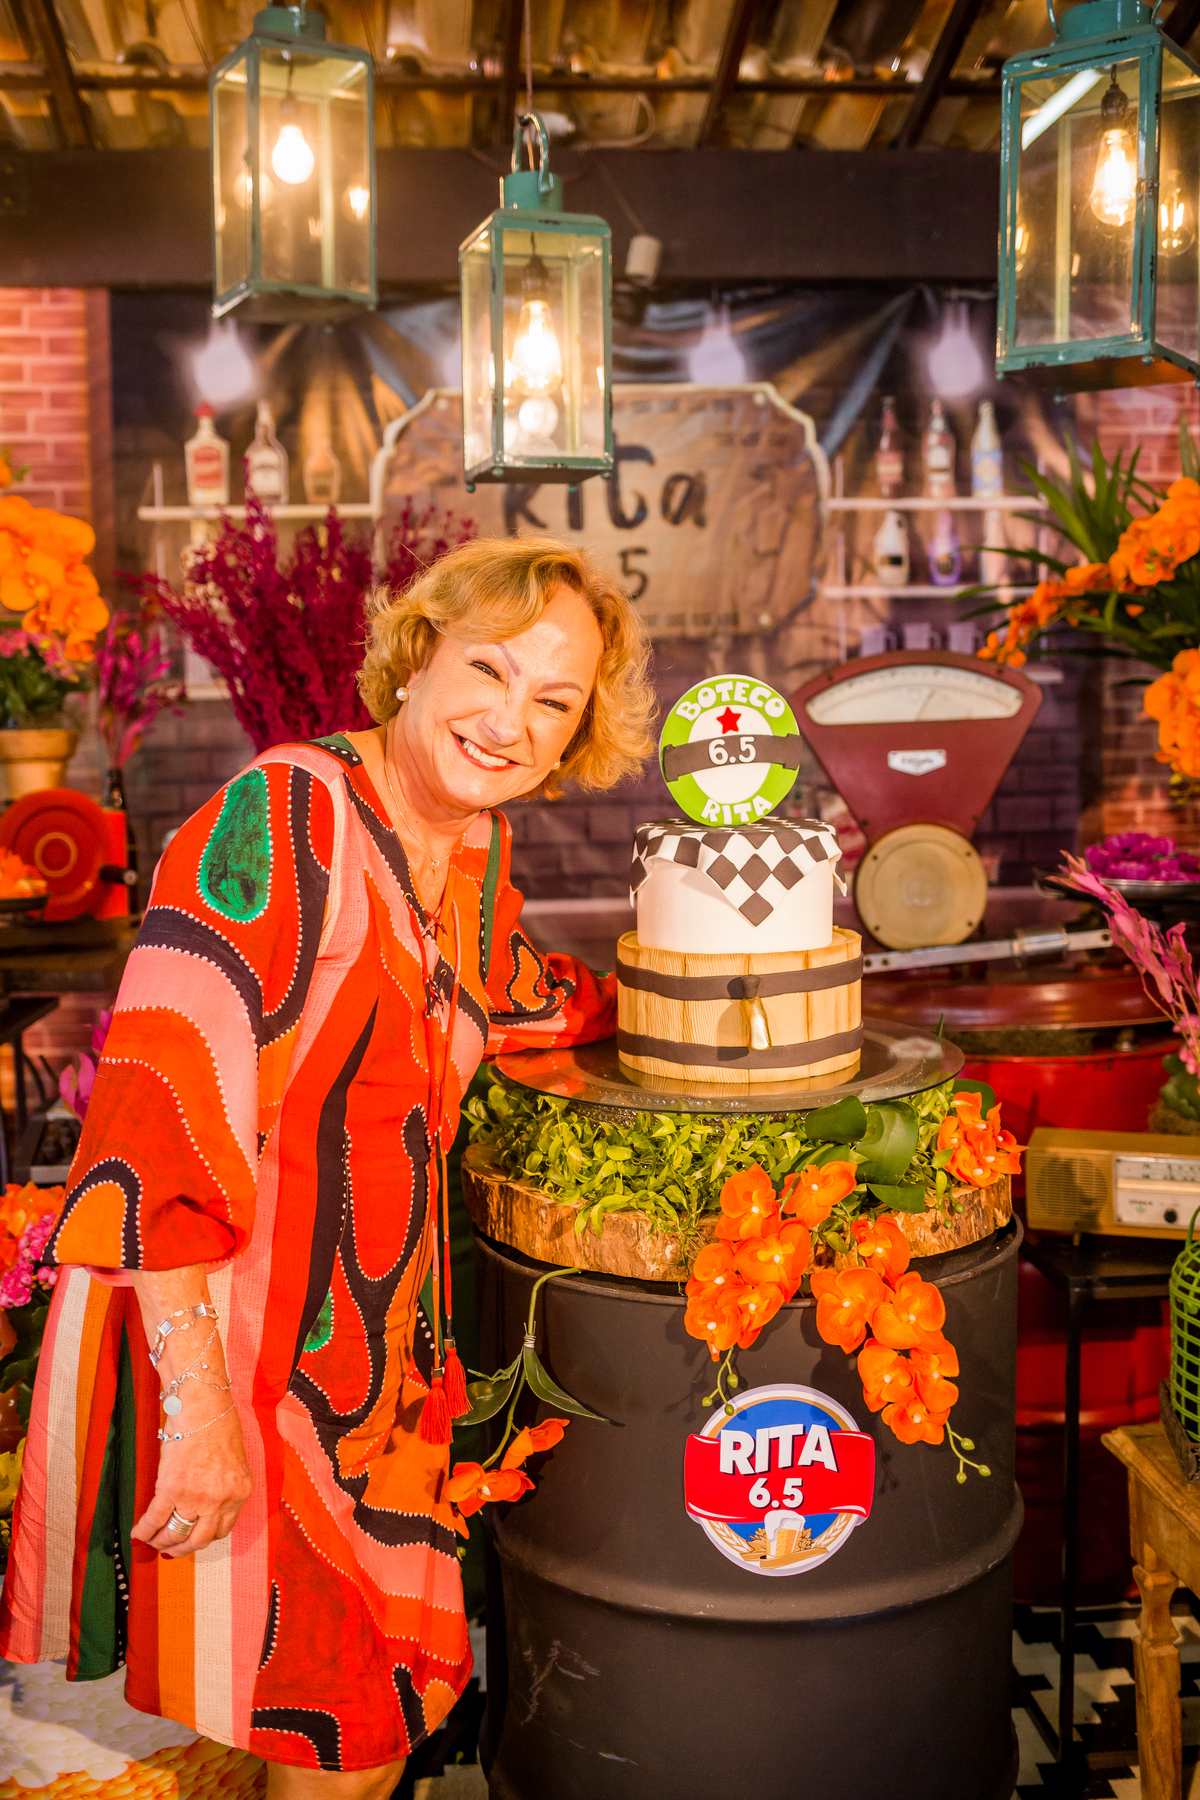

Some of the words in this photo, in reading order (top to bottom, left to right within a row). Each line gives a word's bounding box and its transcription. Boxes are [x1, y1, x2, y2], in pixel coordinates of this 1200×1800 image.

[675, 680, 786, 722] BOTECO
[708, 736, 756, 765] 6.5
[700, 795, 773, 825] RITA
[719, 1423, 839, 1476] RITA
[748, 1477, 804, 1509] 6.5
